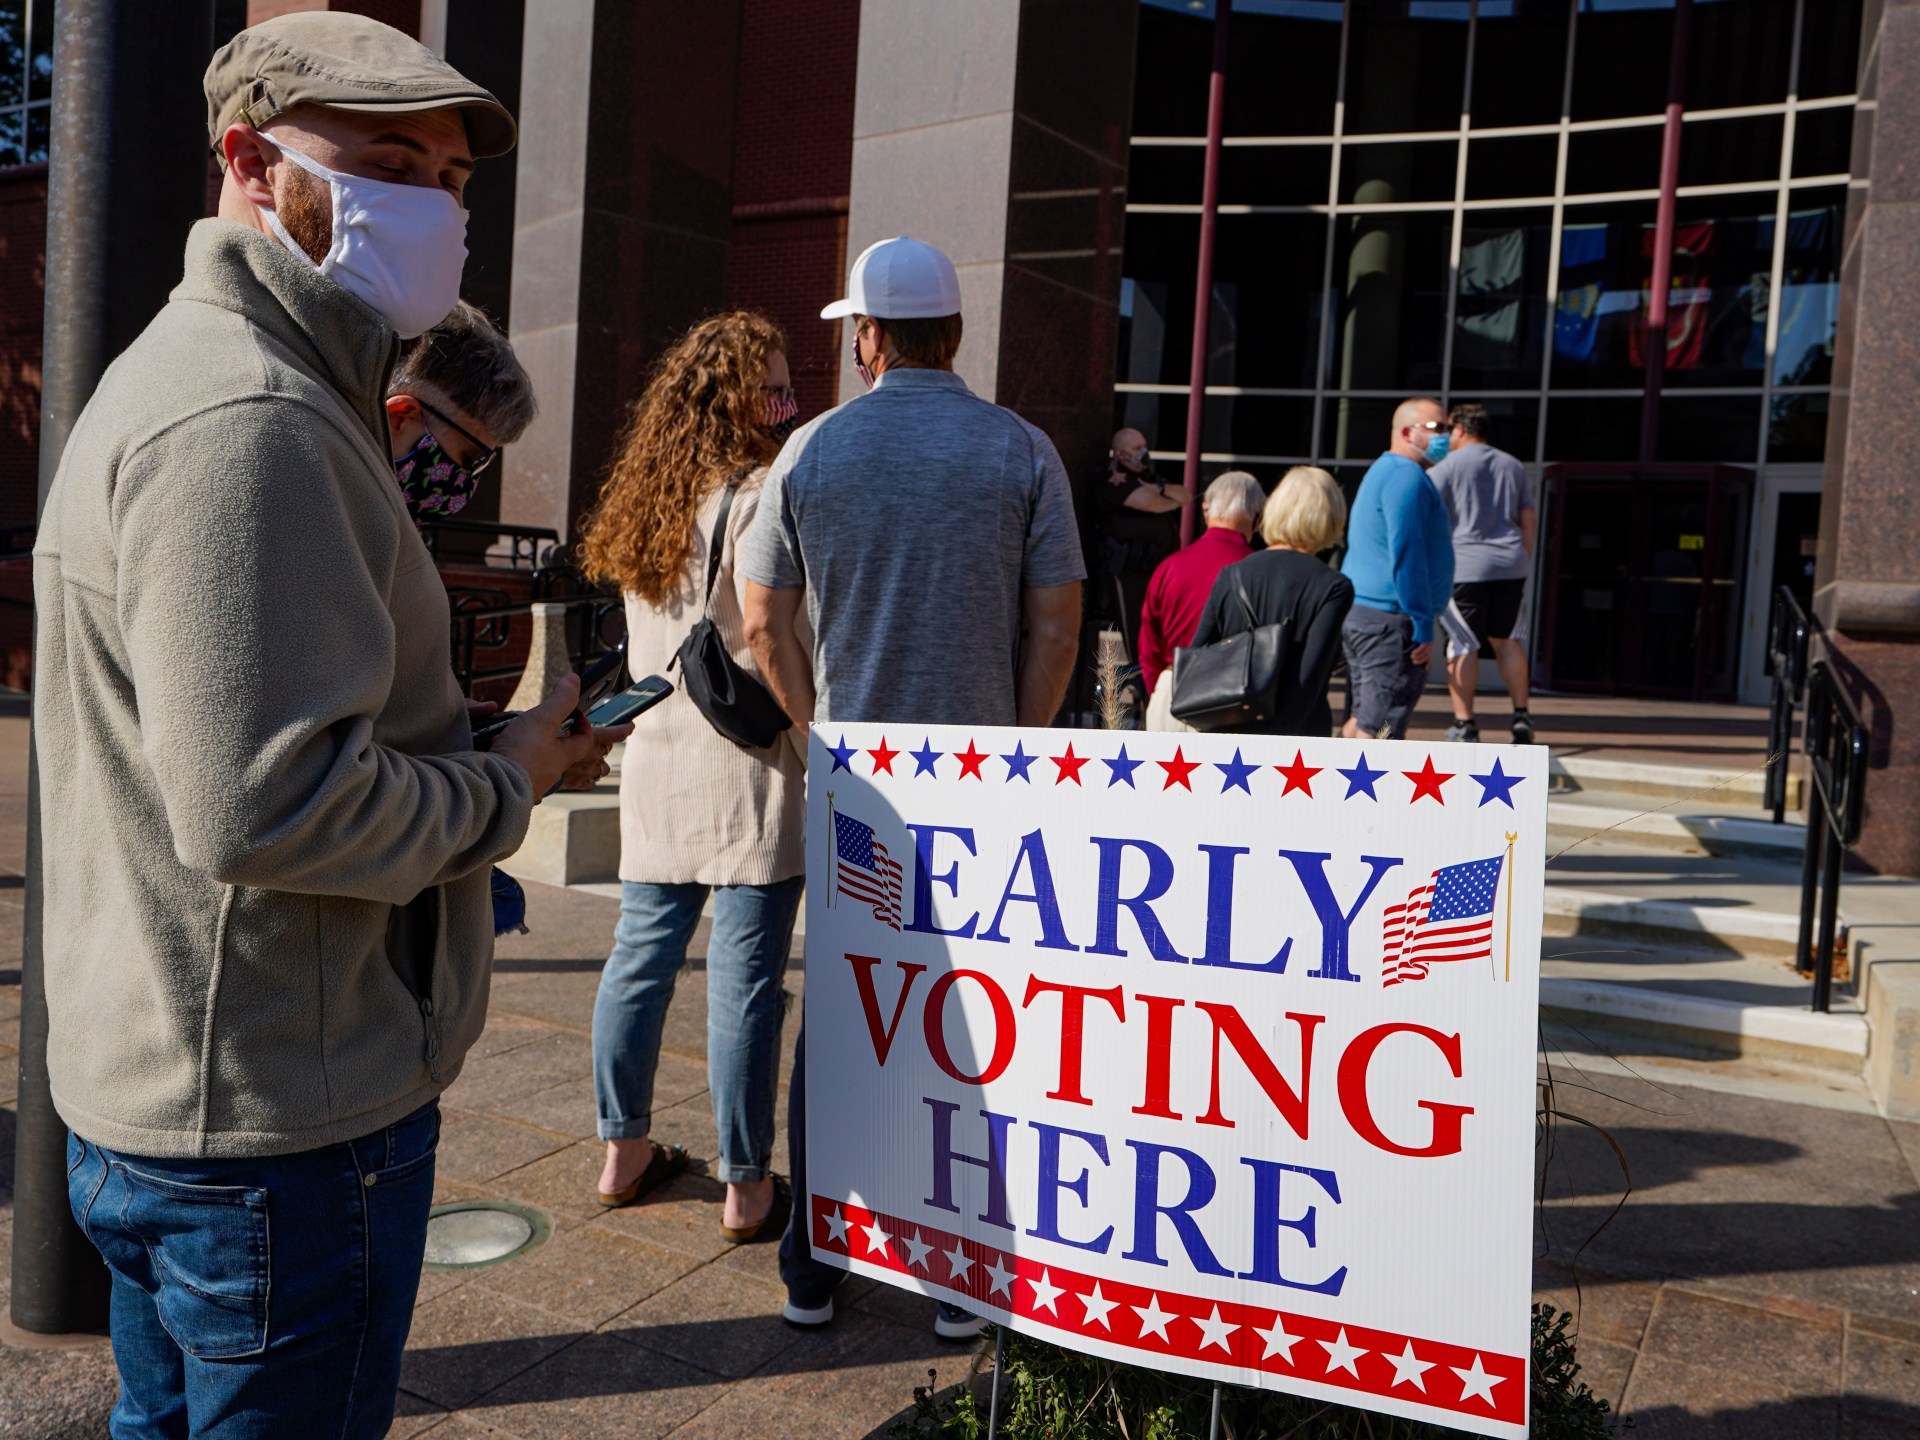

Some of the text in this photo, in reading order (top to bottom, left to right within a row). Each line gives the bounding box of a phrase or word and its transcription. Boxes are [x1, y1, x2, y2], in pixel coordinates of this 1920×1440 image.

[904, 823, 1403, 982] EARLY
[845, 953, 1475, 1157] VOTING
[922, 1097, 1348, 1296] HERE
